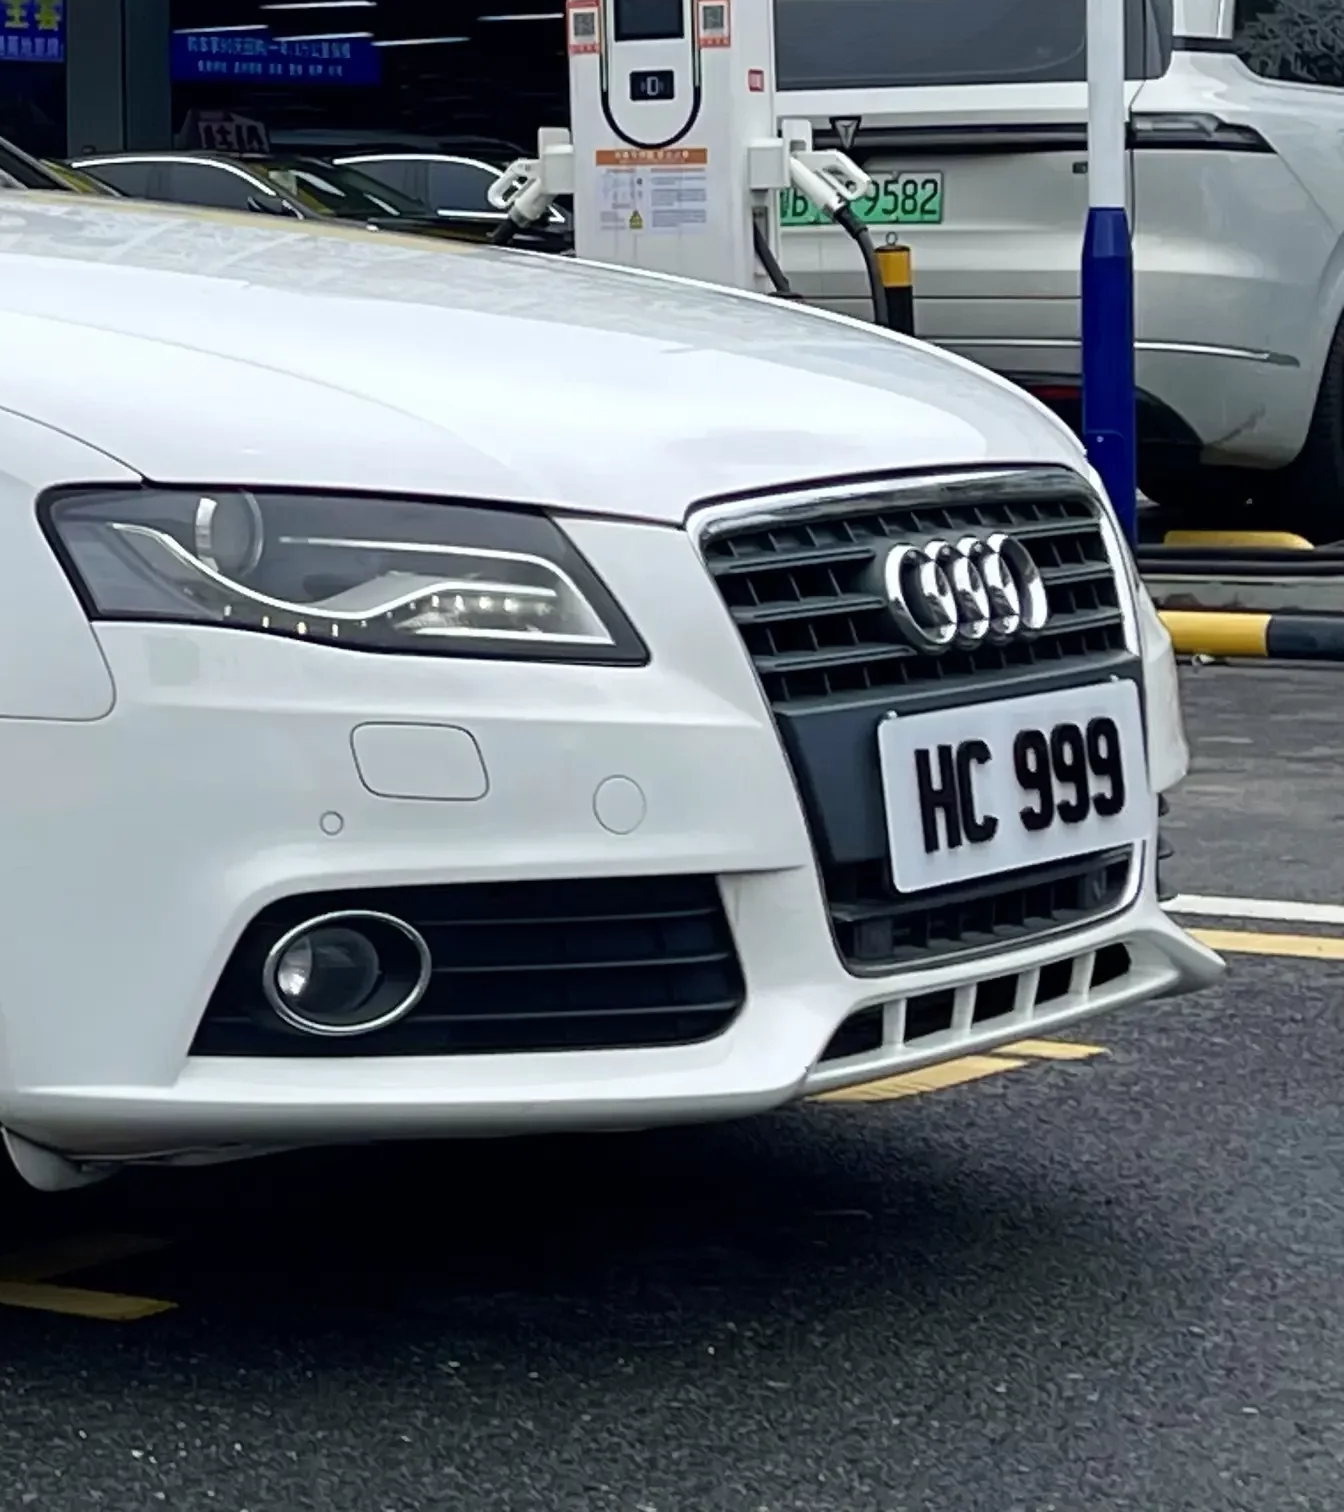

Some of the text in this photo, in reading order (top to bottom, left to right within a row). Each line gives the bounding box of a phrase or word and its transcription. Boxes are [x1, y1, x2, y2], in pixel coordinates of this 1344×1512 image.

[781, 178, 939, 219] B9582
[914, 717, 1127, 855] HC 999
